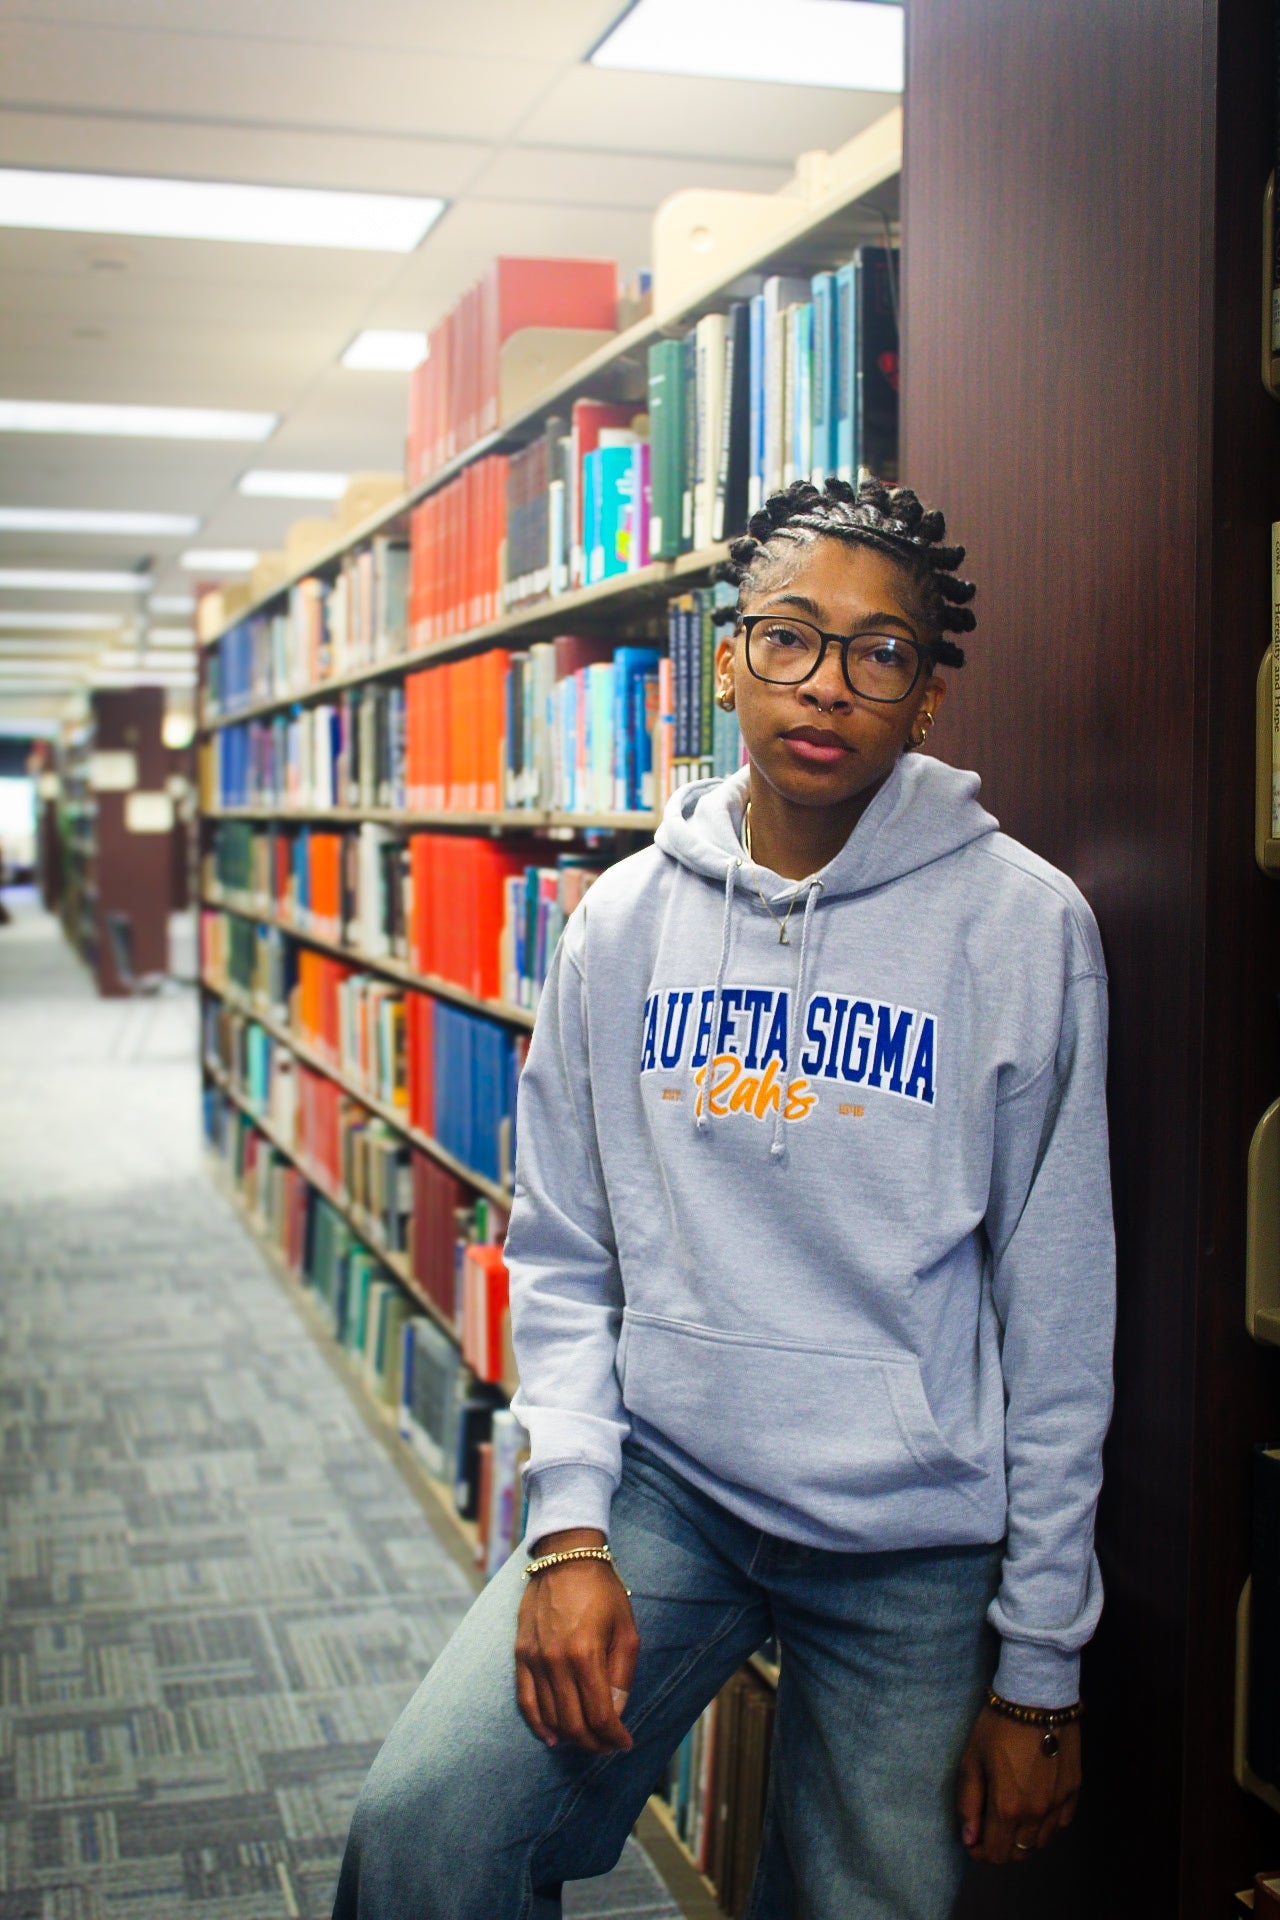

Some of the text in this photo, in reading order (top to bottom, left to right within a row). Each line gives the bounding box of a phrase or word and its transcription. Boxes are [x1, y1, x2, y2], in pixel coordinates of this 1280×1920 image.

[641, 992, 694, 1072] AU
[802, 996, 936, 1104] SIGMA
[695, 1056, 816, 1120] Rahs
